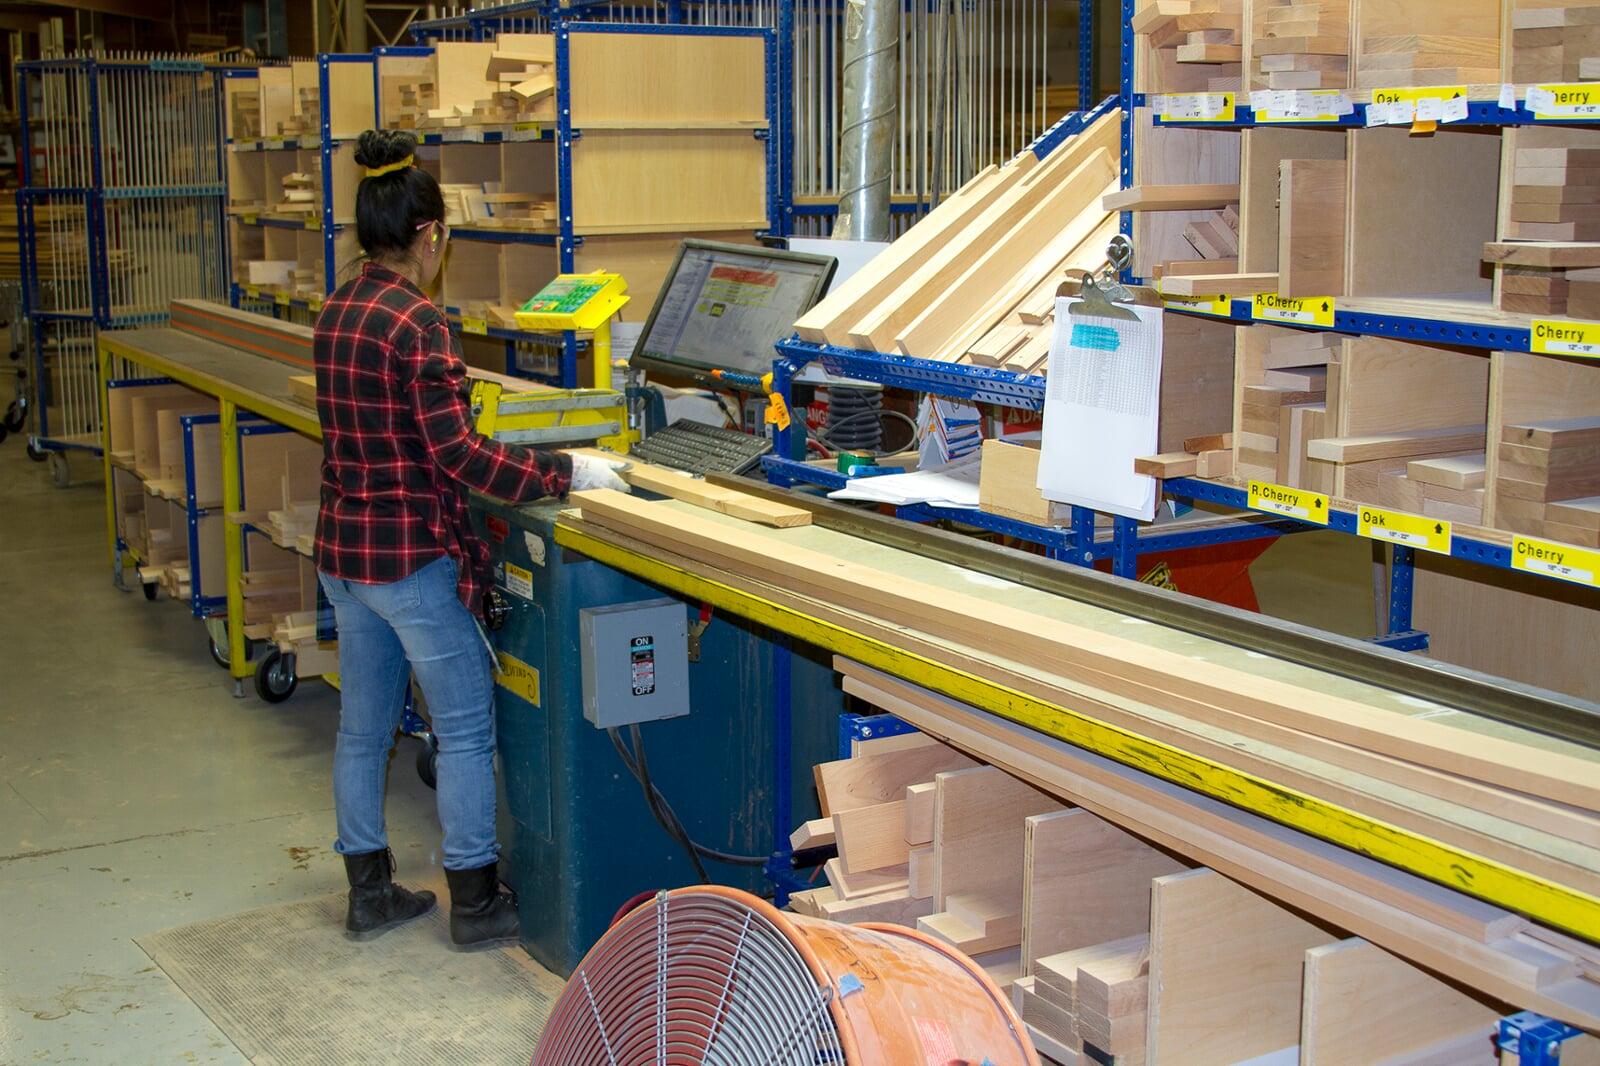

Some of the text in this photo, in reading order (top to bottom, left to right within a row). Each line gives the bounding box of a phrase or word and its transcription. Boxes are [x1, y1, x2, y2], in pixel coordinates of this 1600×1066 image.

[1376, 93, 1400, 105] Oak
[1552, 90, 1590, 105] herry
[1536, 324, 1585, 343] Cherry
[1363, 511, 1386, 526] Oak
[1517, 541, 1565, 565] Cherry
[635, 637, 649, 646] ON
[635, 686, 652, 695] OFF
